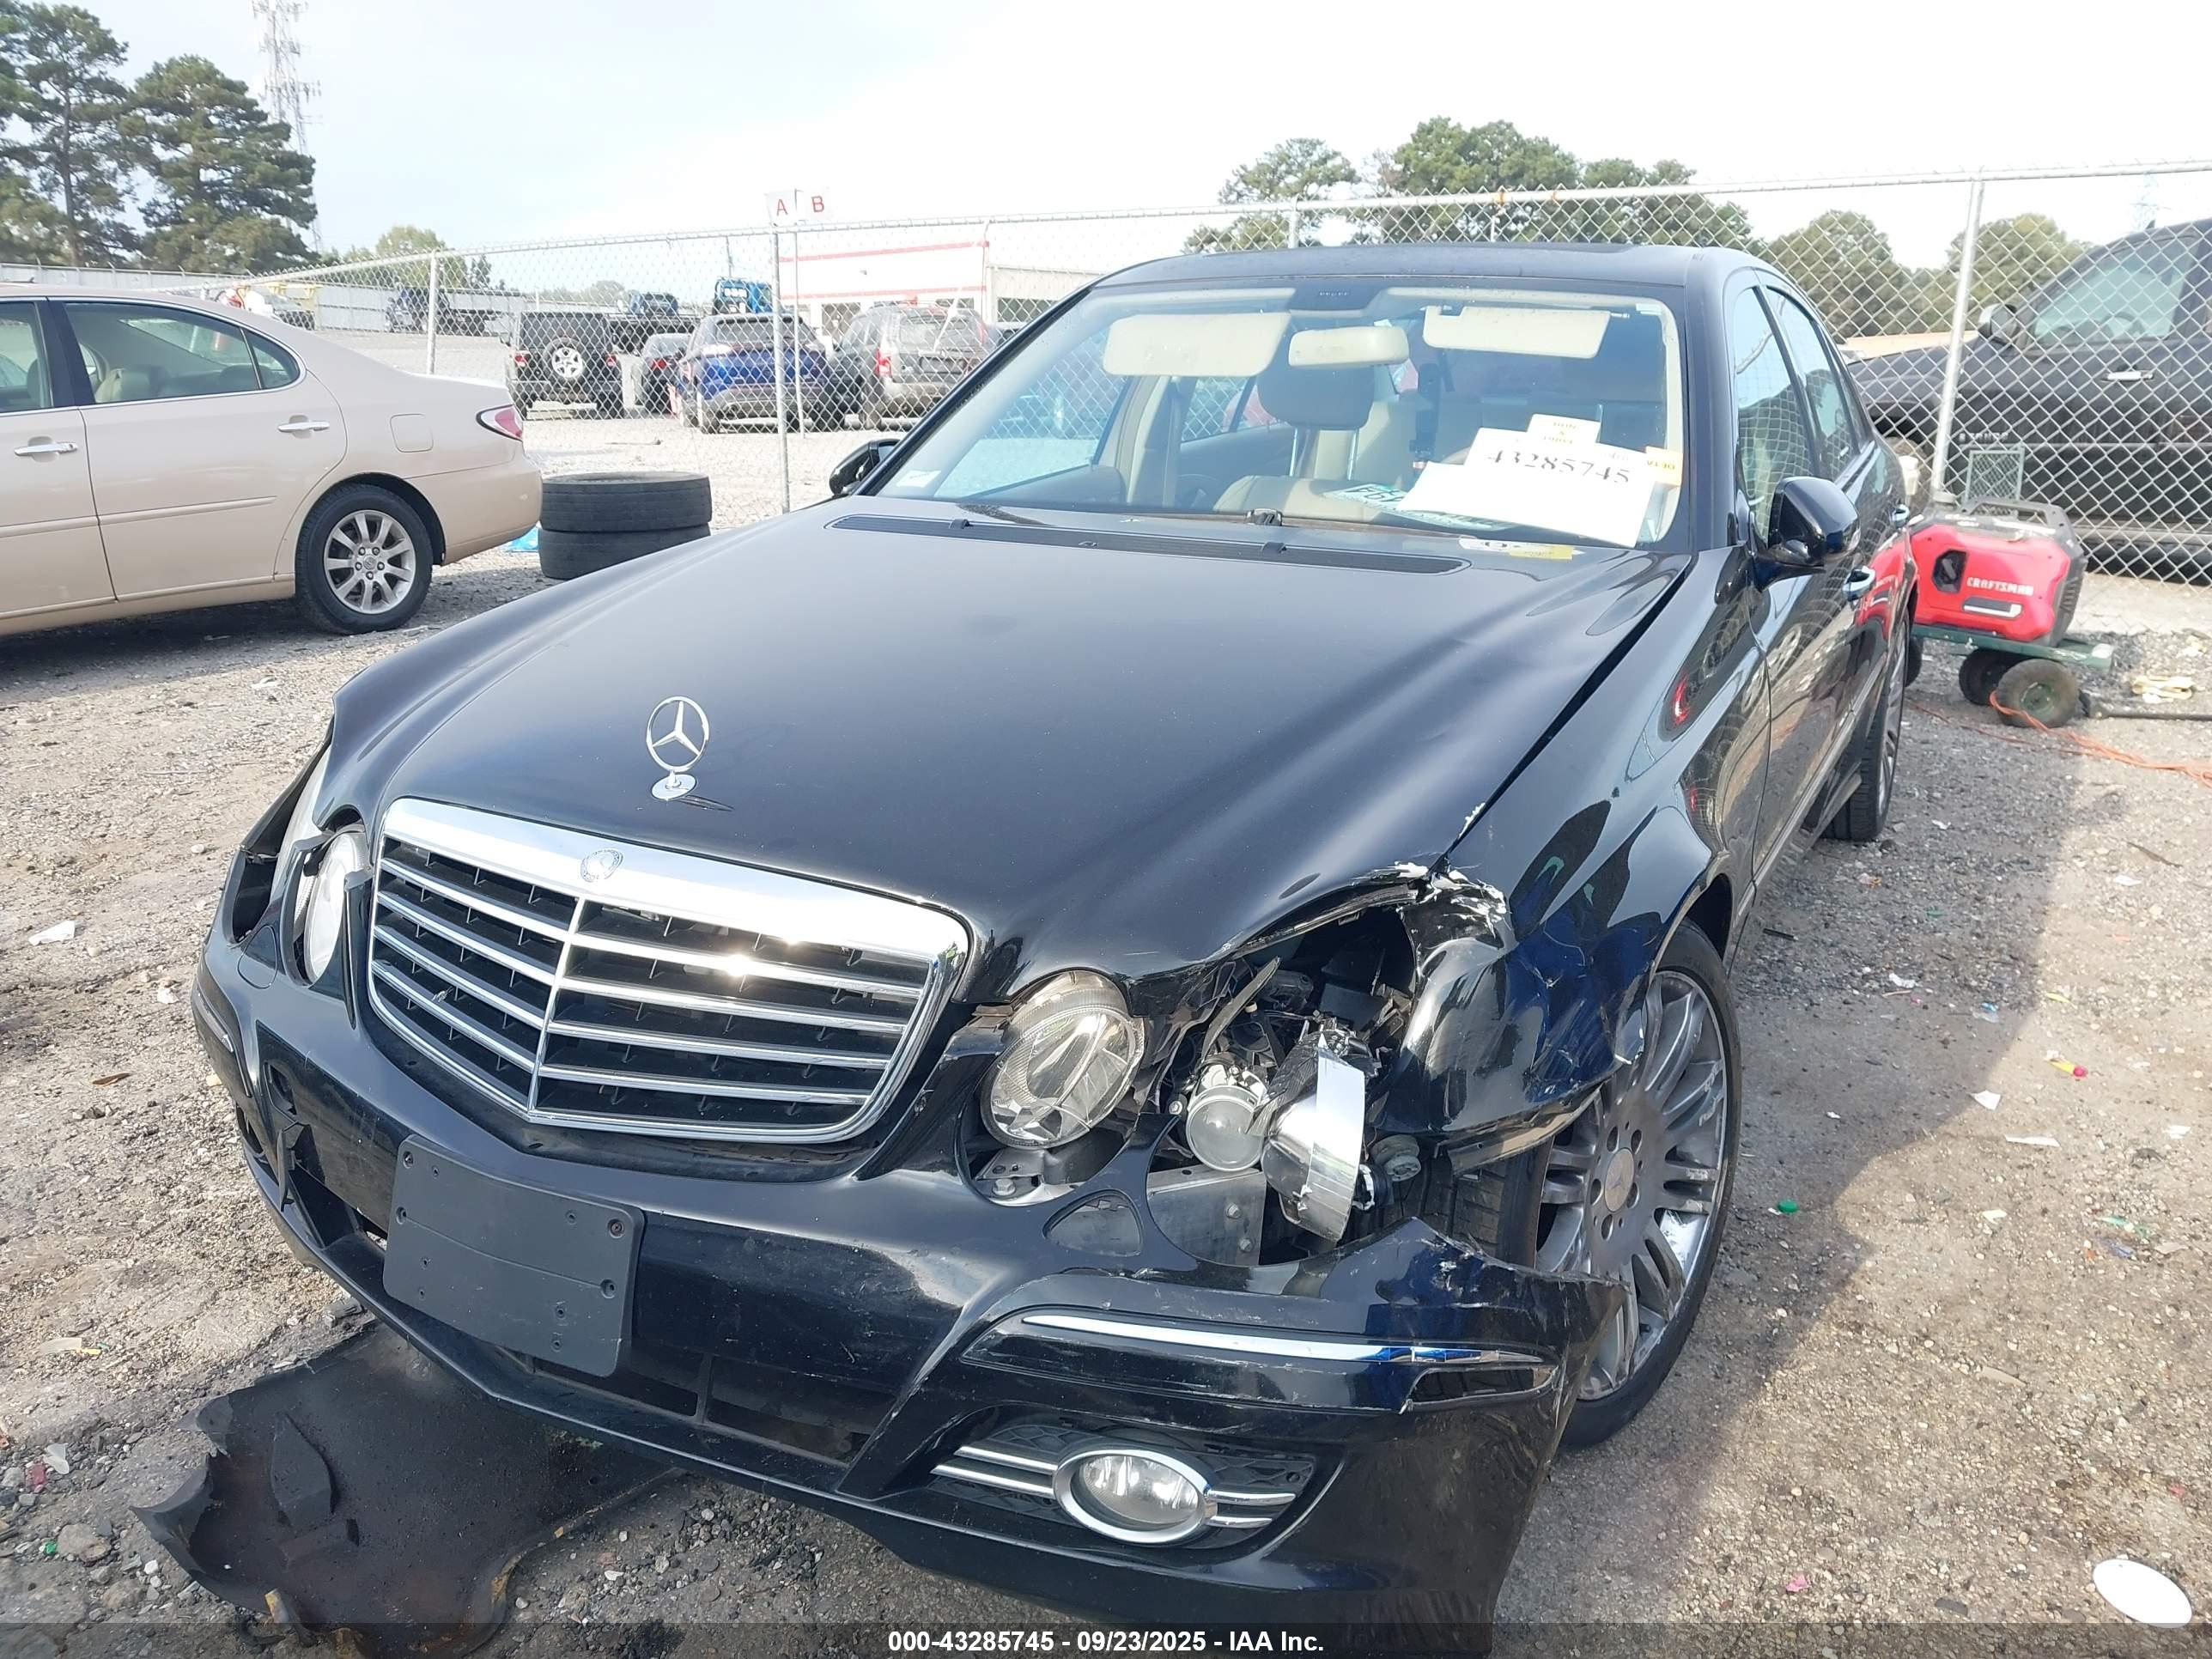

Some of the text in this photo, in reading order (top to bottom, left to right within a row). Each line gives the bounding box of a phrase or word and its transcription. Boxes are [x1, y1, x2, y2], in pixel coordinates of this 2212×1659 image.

[776, 198, 788, 216] A
[811, 195, 825, 213] B
[1487, 450, 1630, 483] 43285745
[1966, 576, 2034, 597] CRAFTSMAN
